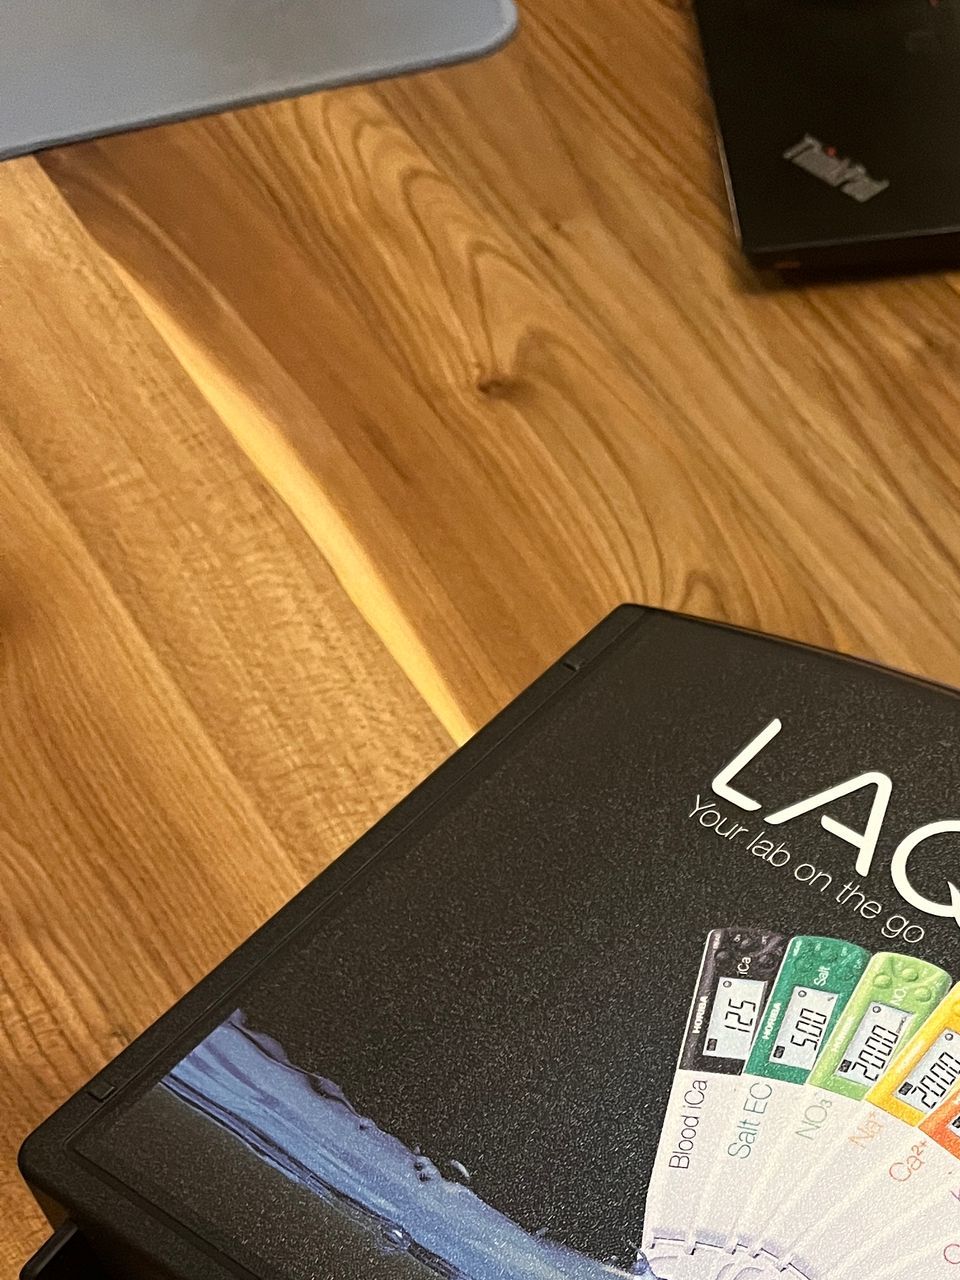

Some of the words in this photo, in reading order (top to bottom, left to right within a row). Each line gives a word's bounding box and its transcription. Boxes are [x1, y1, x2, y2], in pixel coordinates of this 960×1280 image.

[688, 795, 749, 841] Your
[746, 831, 791, 868] lab
[794, 863, 833, 892] on
[836, 881, 882, 919] the
[881, 915, 925, 943] go
[737, 957, 751, 976] iCa
[814, 966, 830, 987] Salt
[692, 996, 708, 1034] HORIBA
[725, 998, 756, 1033] 125
[762, 1003, 781, 1040] HORIBA
[790, 1008, 827, 1050] 5.00
[851, 1025, 899, 1082] 2000
[682, 1079, 708, 1110] iCa
[743, 1082, 773, 1114] EC
[668, 1114, 700, 1169] Blood
[727, 1119, 760, 1160] Salt
